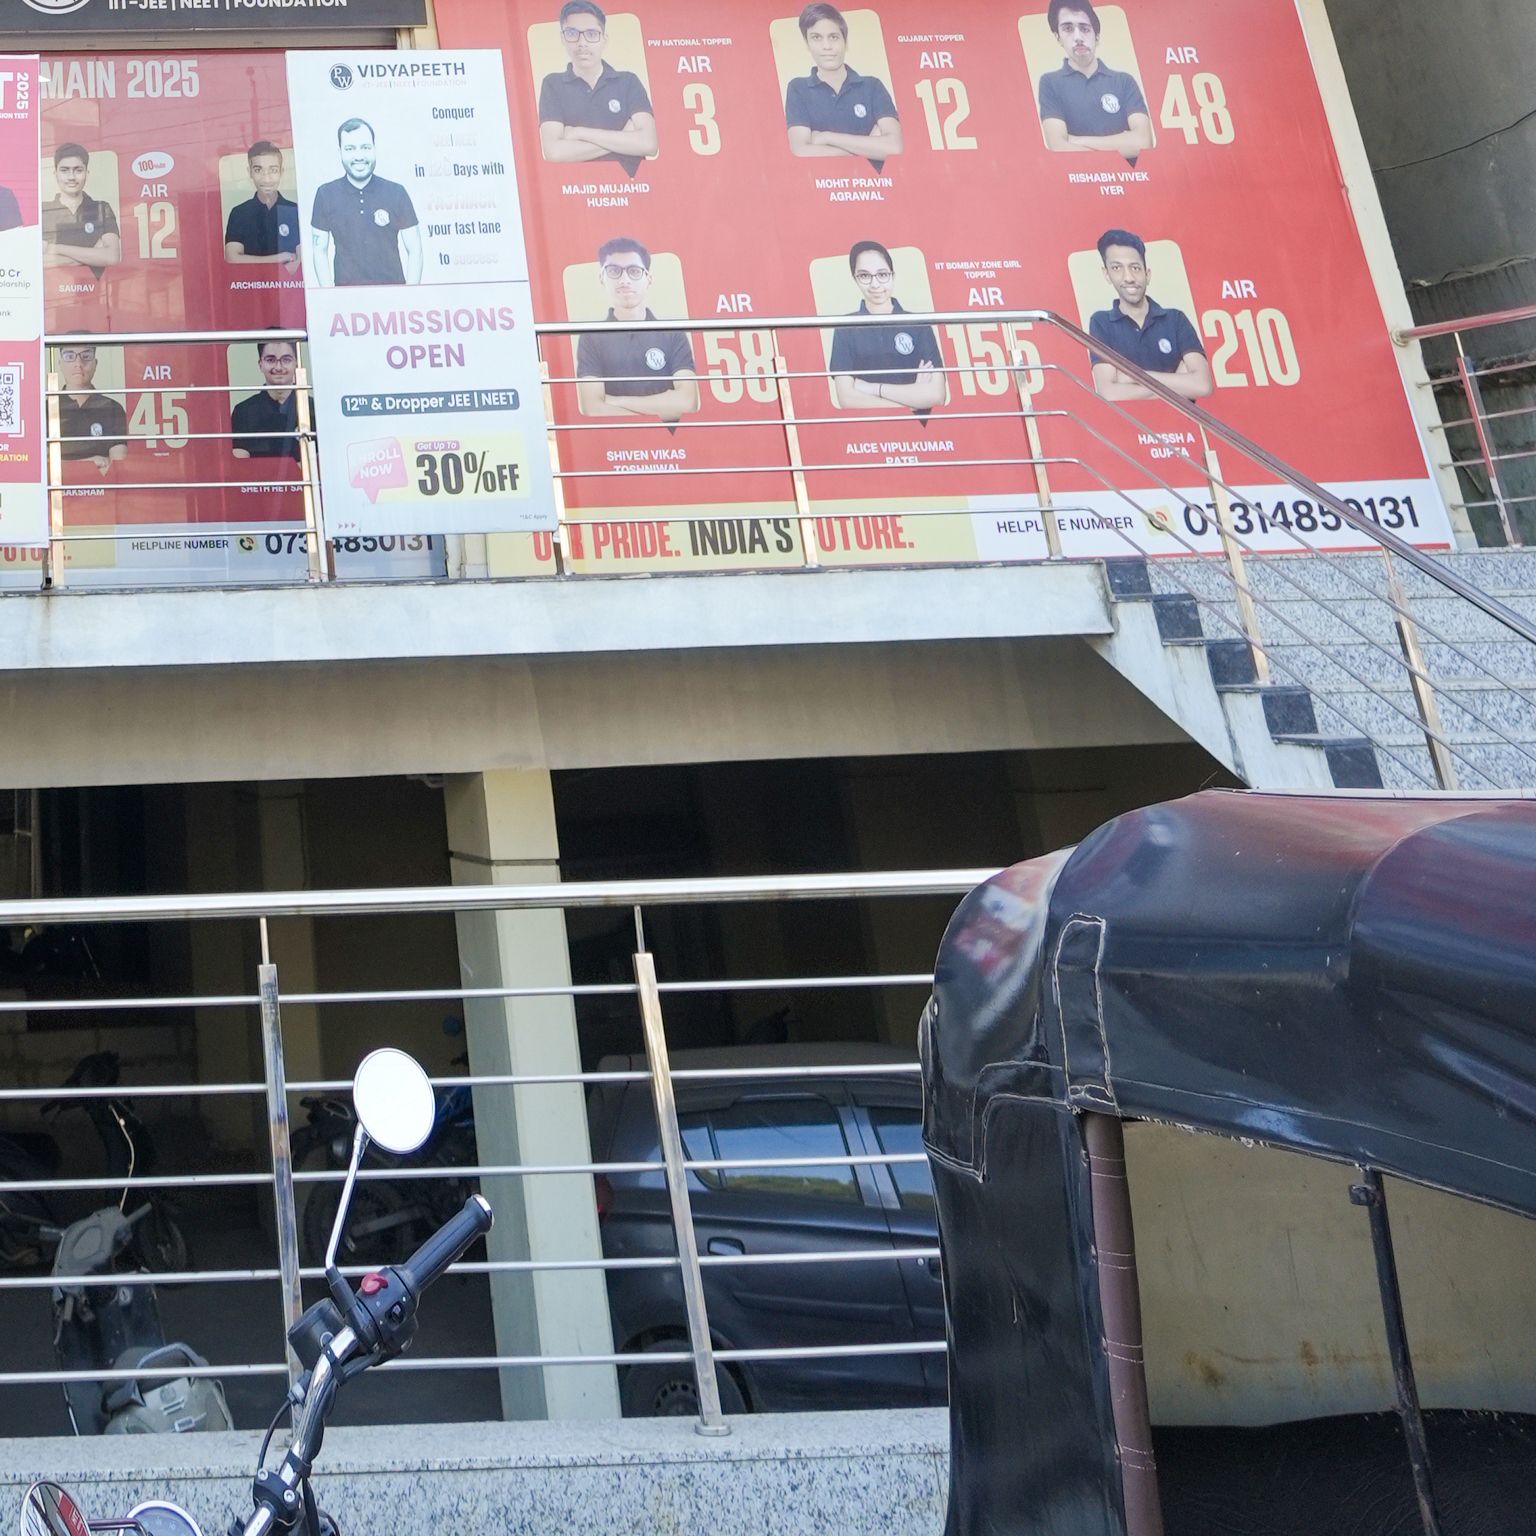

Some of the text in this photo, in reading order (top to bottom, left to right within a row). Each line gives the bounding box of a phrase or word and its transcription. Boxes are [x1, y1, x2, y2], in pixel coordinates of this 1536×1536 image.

[919, 51, 954, 70] AIR
[1164, 46, 1200, 66] AIR
[357, 62, 465, 78] VIDYAPEETH
[676, 55, 713, 74] AIR
[127, 60, 199, 98] 2025
[432, 106, 475, 120] Conquer
[914, 77, 978, 151] 12
[1159, 71, 1236, 146] 48
[682, 82, 722, 157] 3
[415, 163, 424, 177] in
[453, 163, 478, 177] Days
[482, 161, 504, 176] with
[815, 177, 893, 190] MOHIT PRAVIN
[1068, 171, 1150, 184] RISHABH VIVEK
[140, 184, 168, 198] AIR
[562, 183, 650, 196] MAJID MUJAHID
[829, 190, 884, 202] AGRAWAL
[1100, 185, 1125, 196] IYER
[586, 196, 629, 208] HUSAIN
[133, 201, 177, 259] 12
[427, 223, 451, 237] your
[479, 220, 501, 235] lane
[439, 251, 450, 266] to
[58, 284, 95, 292] SAURAV
[230, 281, 282, 290] ARCHISMAN
[1221, 279, 1257, 300] AIR
[716, 294, 753, 313] AIR
[967, 287, 1004, 307] AIR
[329, 307, 515, 337] ADMISSIONS
[386, 343, 466, 369] OPEN
[1201, 307, 1301, 389] 210
[143, 366, 172, 380] AIR
[703, 331, 779, 404] 58
[371, 397, 383, 410] &
[386, 394, 444, 413] Dropper
[448, 393, 471, 407] JEE
[482, 392, 515, 406] NEET
[128, 391, 189, 449] 45
[1186, 432, 1195, 443] A
[606, 448, 686, 461] SHIVEN VIKAS
[846, 441, 954, 454] ALICE VIPULKUMAR
[131, 539, 229, 551] HELPLINE NUMBER
